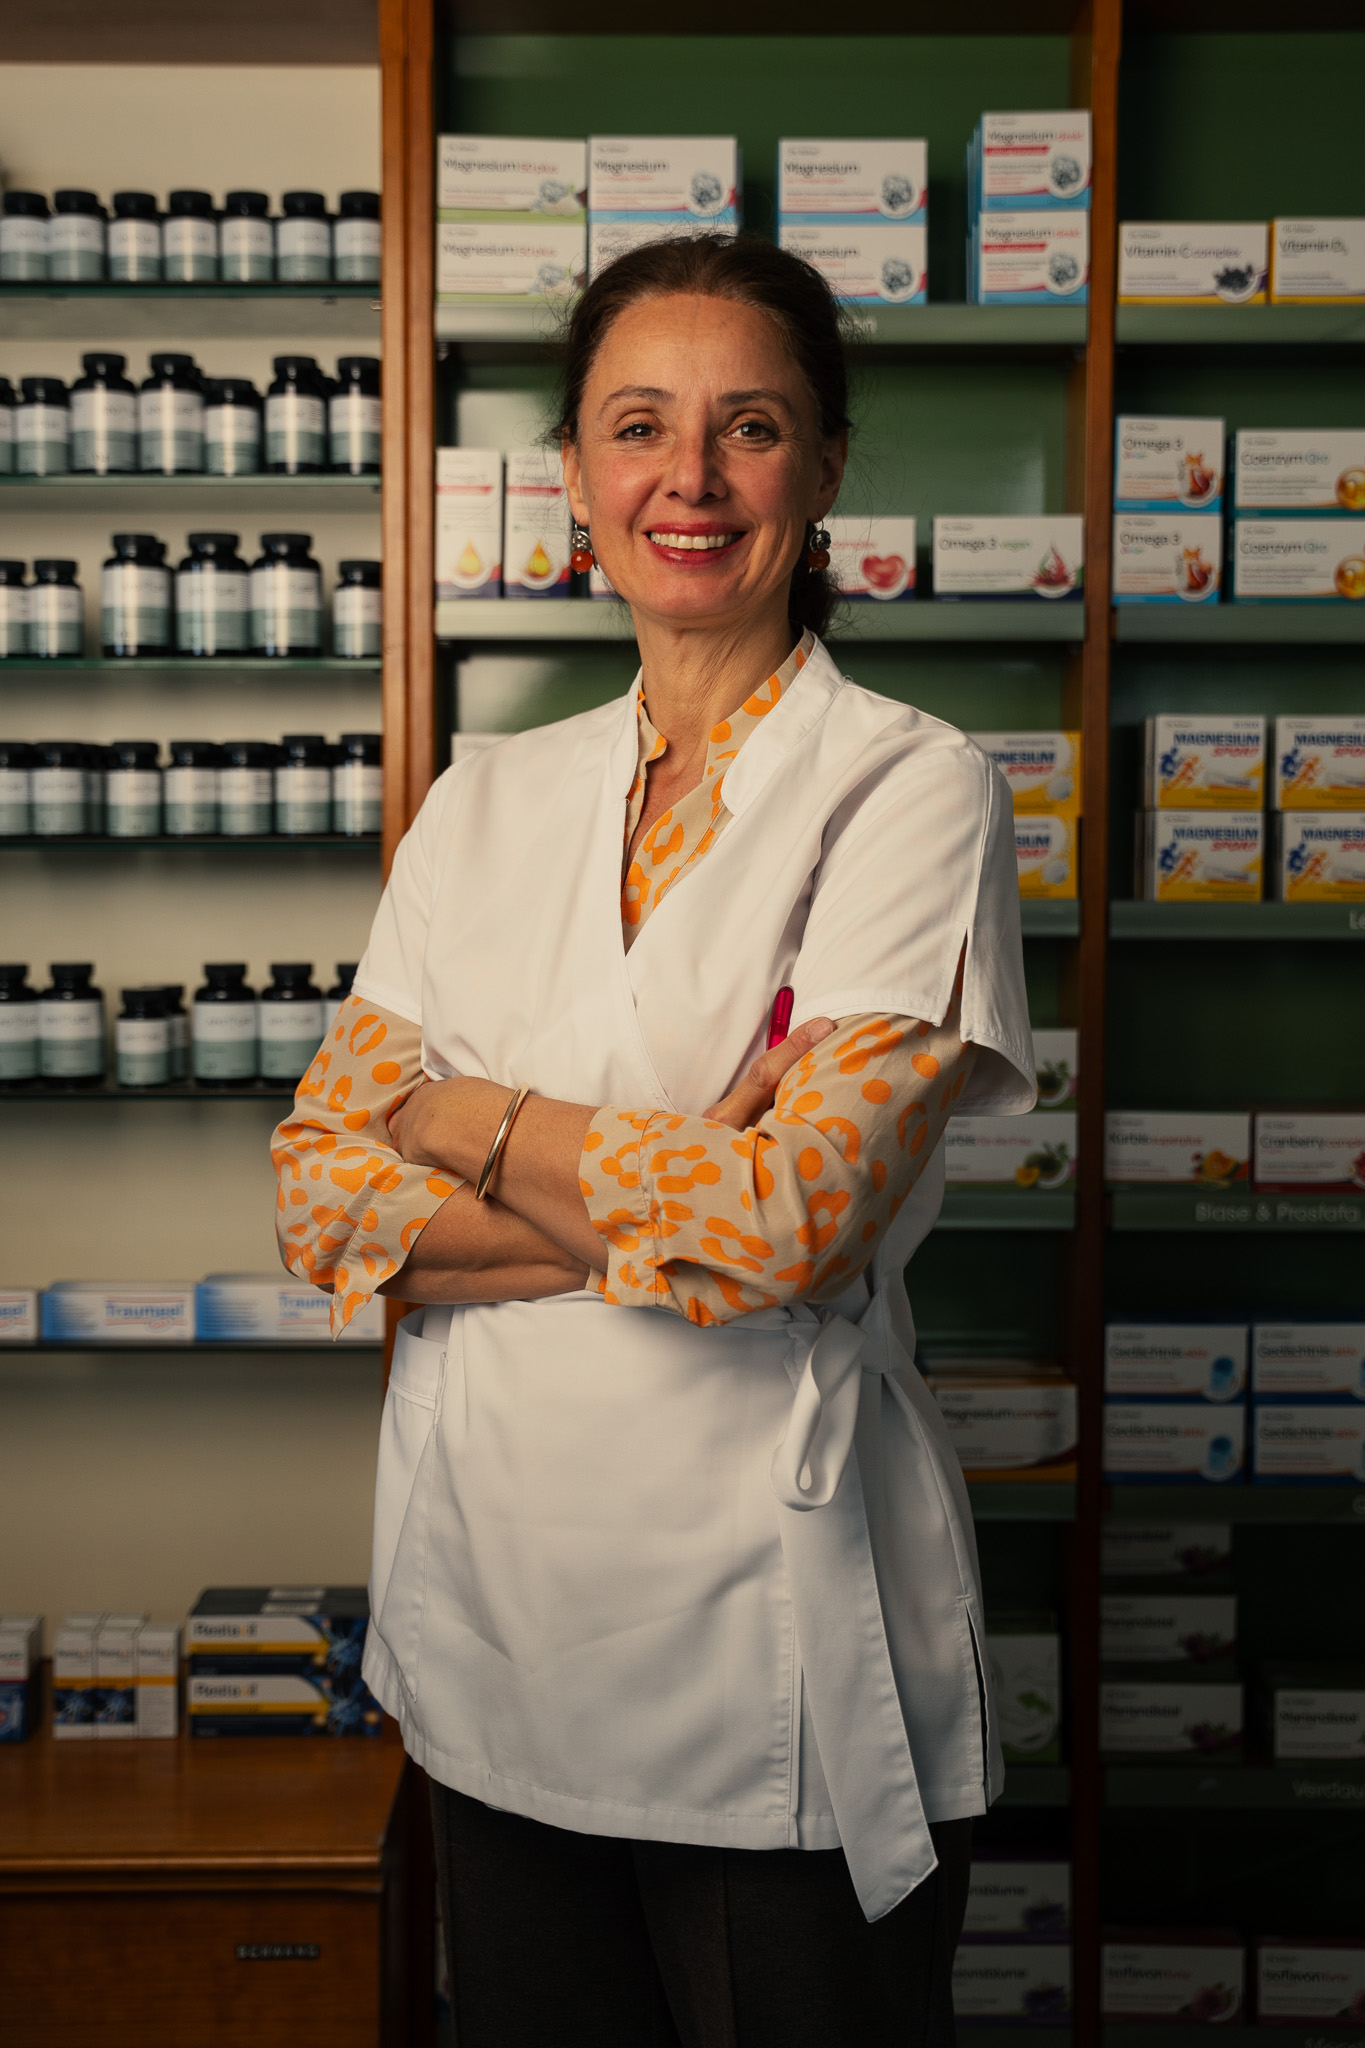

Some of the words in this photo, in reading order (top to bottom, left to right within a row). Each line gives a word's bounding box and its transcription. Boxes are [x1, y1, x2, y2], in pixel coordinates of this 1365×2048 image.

[594, 160, 669, 175] Magnesium
[785, 162, 860, 177] Magnesium
[1124, 245, 1177, 258] Vitamin
[1179, 244, 1191, 258] C
[1279, 239, 1331, 254] Vitamin
[1122, 437, 1170, 453] Omega
[1173, 438, 1183, 451] 3
[1241, 451, 1303, 467] Coenzym
[939, 539, 986, 553] Omega
[987, 539, 997, 551] 3
[1120, 532, 1168, 548] Omega
[1170, 533, 1181, 546] 3
[1240, 541, 1302, 557] Coenzym
[1174, 733, 1260, 747] MAGNESIUM
[1212, 747, 1259, 758] SPORT
[1007, 764, 1054, 776] SPORT
[1172, 828, 1258, 841] MAGNESIUM
[1211, 841, 1258, 852] SPORT
[1260, 1134, 1325, 1151] Cranberry
[1196, 1202, 1250, 1222] Blase
[1255, 1202, 1271, 1222] &
[1276, 1202, 1361, 1222] Prostata
[105, 1302, 184, 1319] Traumeel
